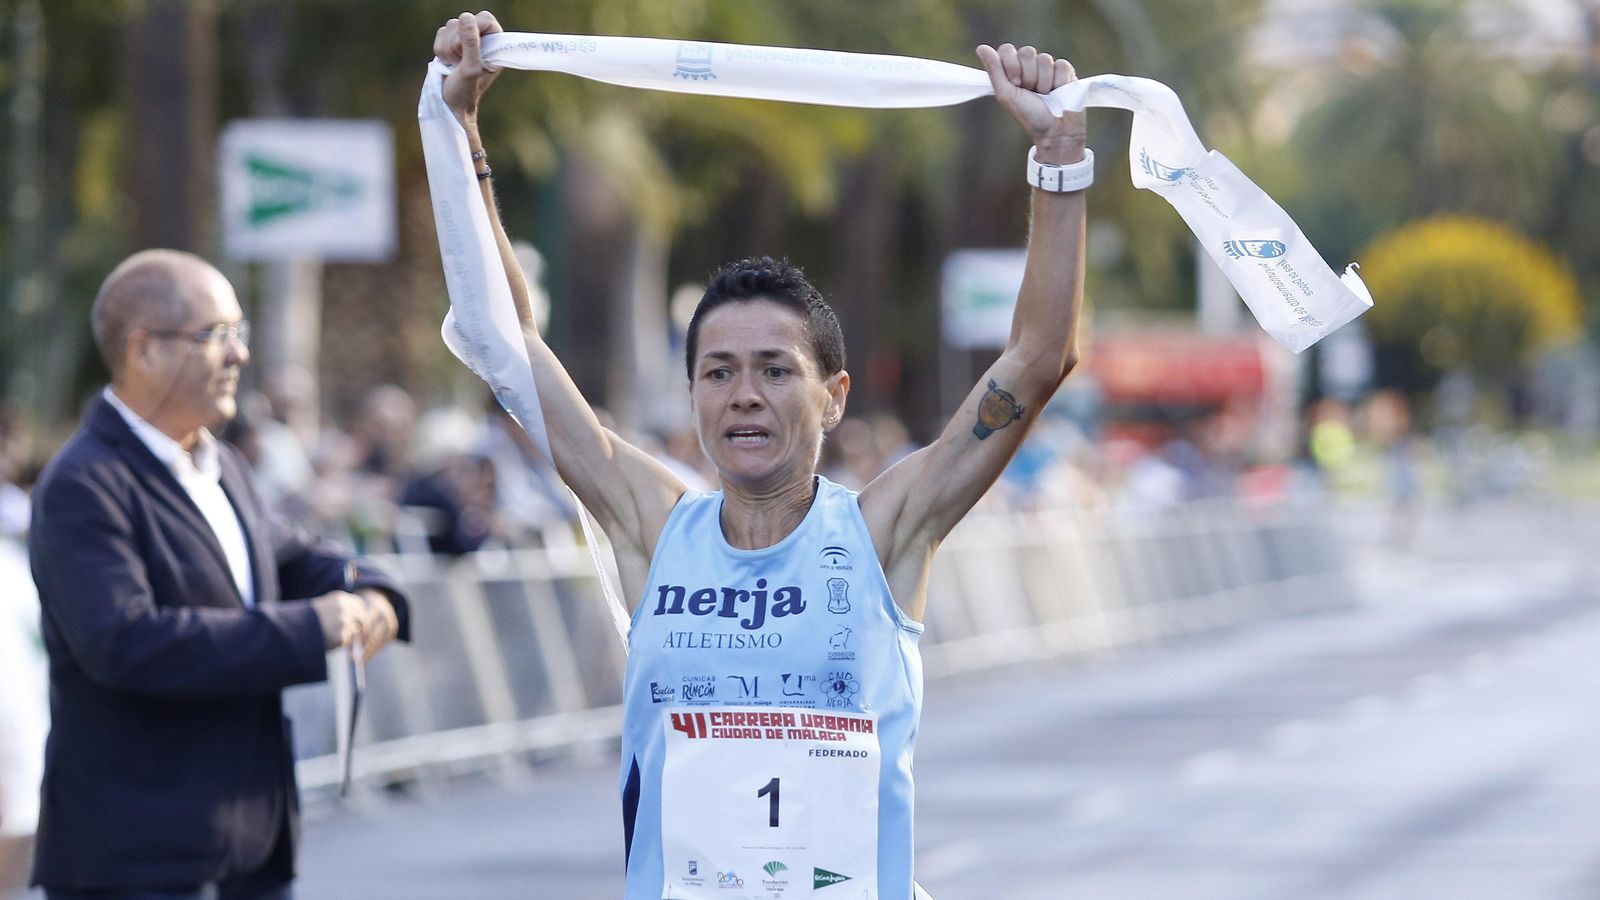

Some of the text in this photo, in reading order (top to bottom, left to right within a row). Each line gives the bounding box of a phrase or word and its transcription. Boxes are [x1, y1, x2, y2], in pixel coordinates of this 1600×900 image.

[653, 578, 807, 630] nerja
[662, 631, 783, 649] ATLETISMO
[825, 698, 853, 709] NERJA
[670, 713, 707, 739] 41
[709, 712, 873, 733] CARRERA URBANA
[712, 727, 848, 741] CIUDAD DE MÁLAGA
[808, 749, 868, 758] FEDERADO
[757, 777, 780, 827] 1
